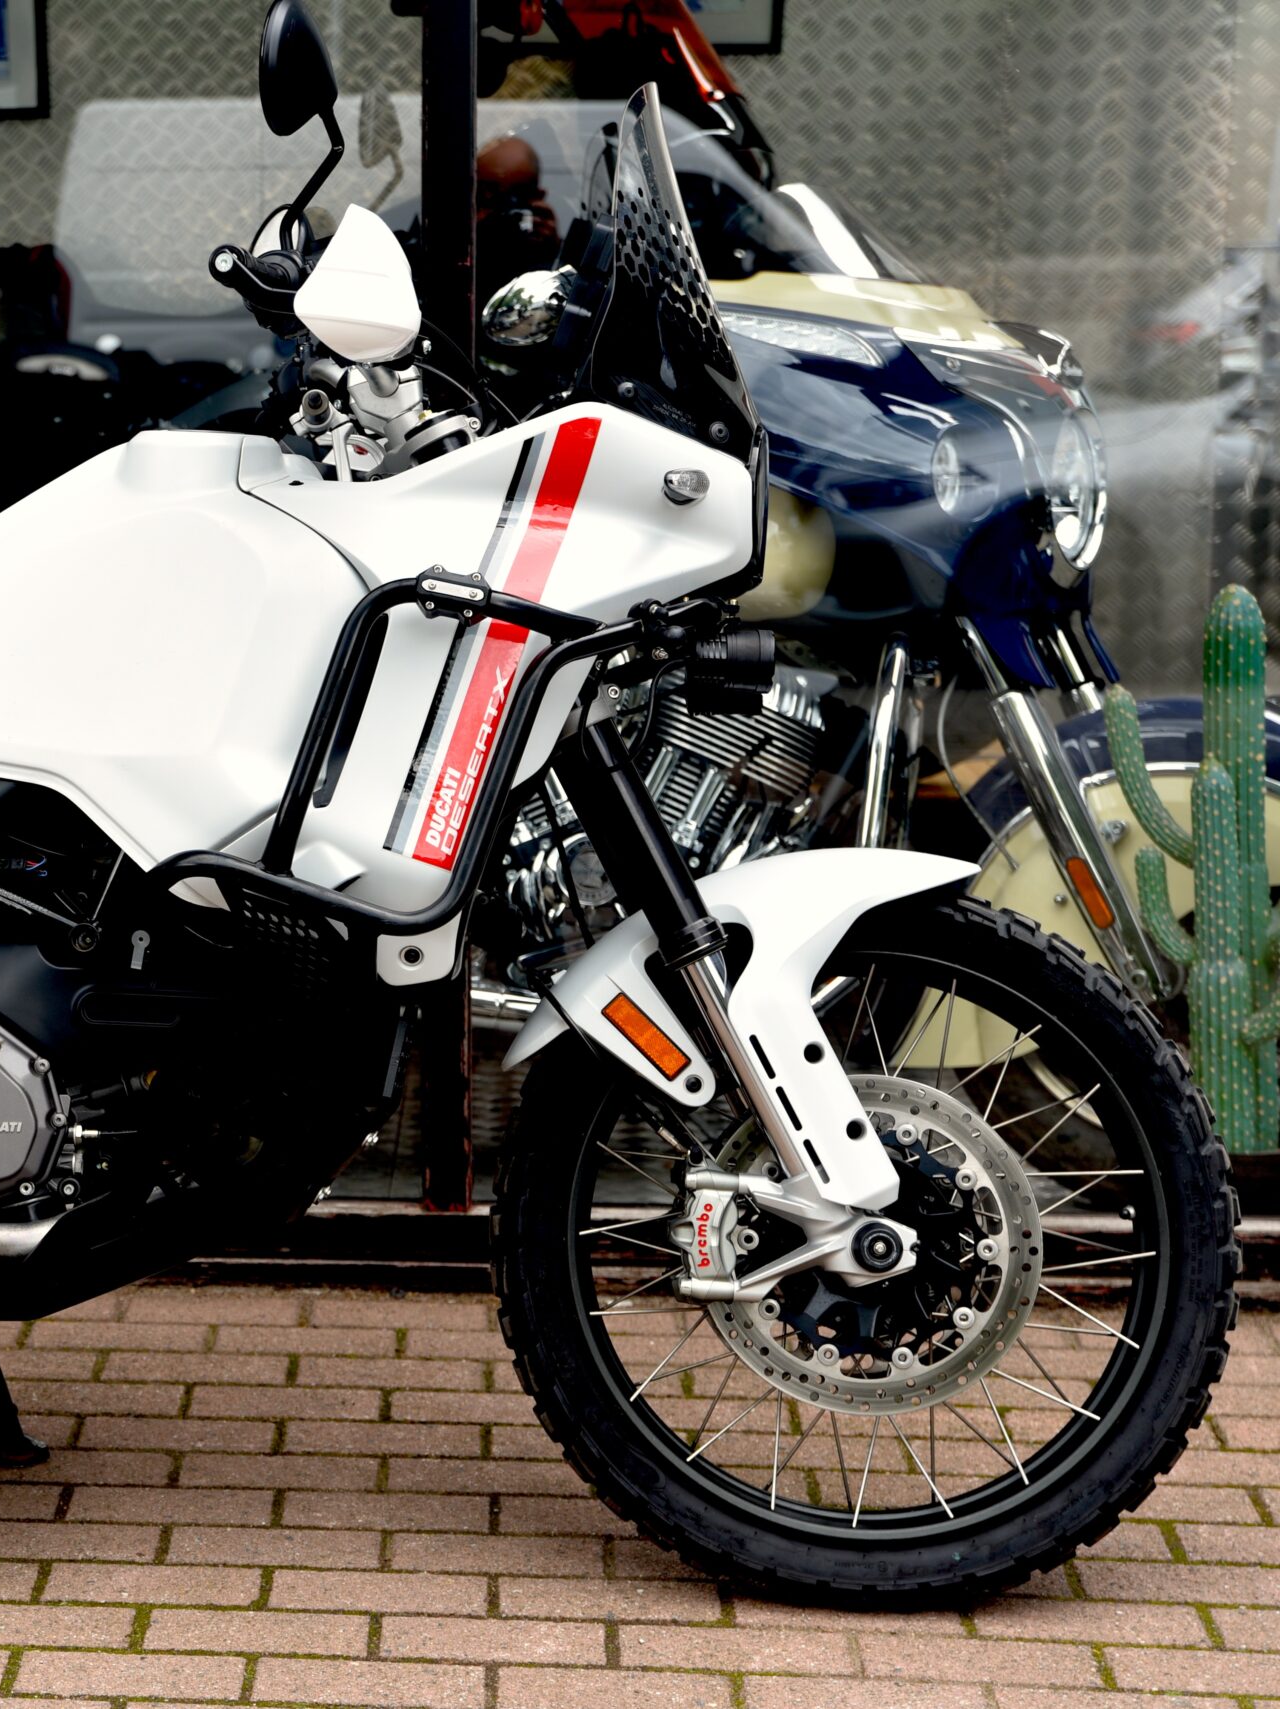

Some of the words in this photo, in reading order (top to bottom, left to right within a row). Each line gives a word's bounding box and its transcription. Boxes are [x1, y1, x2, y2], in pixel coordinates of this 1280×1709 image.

[440, 665, 510, 856] DESERTX
[425, 766, 461, 848] DUCATI
[696, 1203, 713, 1268] brembo
